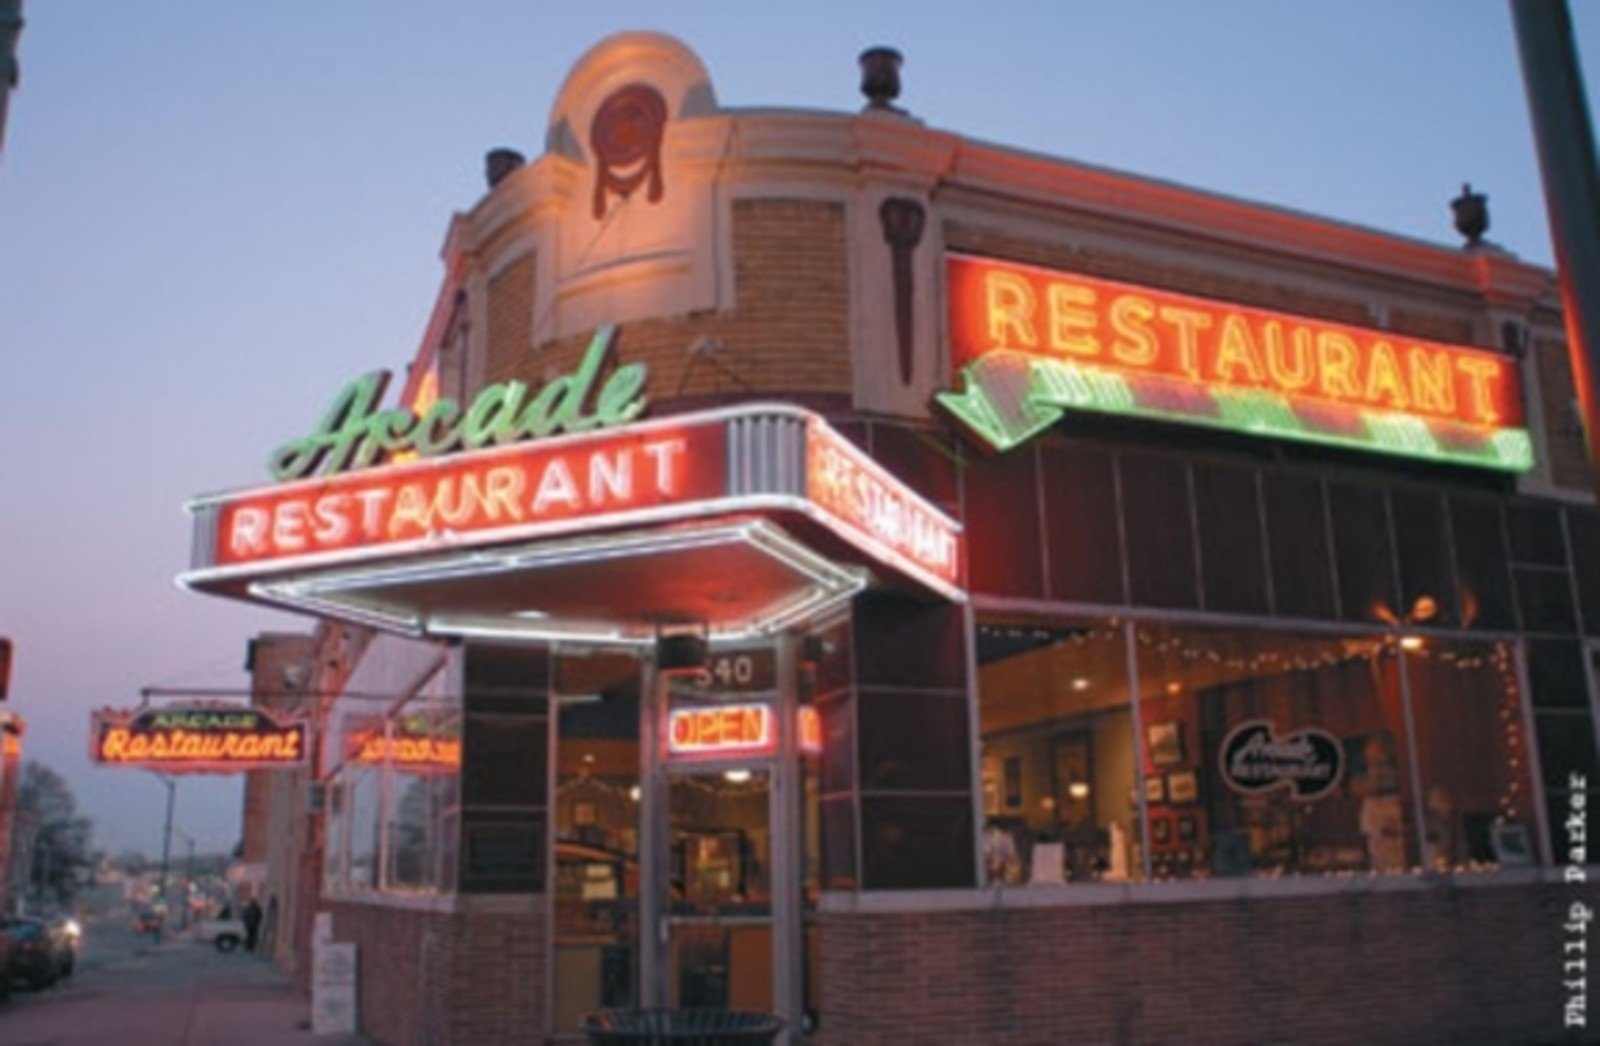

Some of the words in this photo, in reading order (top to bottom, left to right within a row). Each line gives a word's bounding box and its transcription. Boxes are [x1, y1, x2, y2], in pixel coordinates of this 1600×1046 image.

[268, 322, 650, 482] Arcade
[984, 269, 1502, 428] RESTAURANT
[230, 437, 688, 557] RESTAURANT
[151, 711, 260, 730] ARCADE
[674, 706, 764, 746] OPEN
